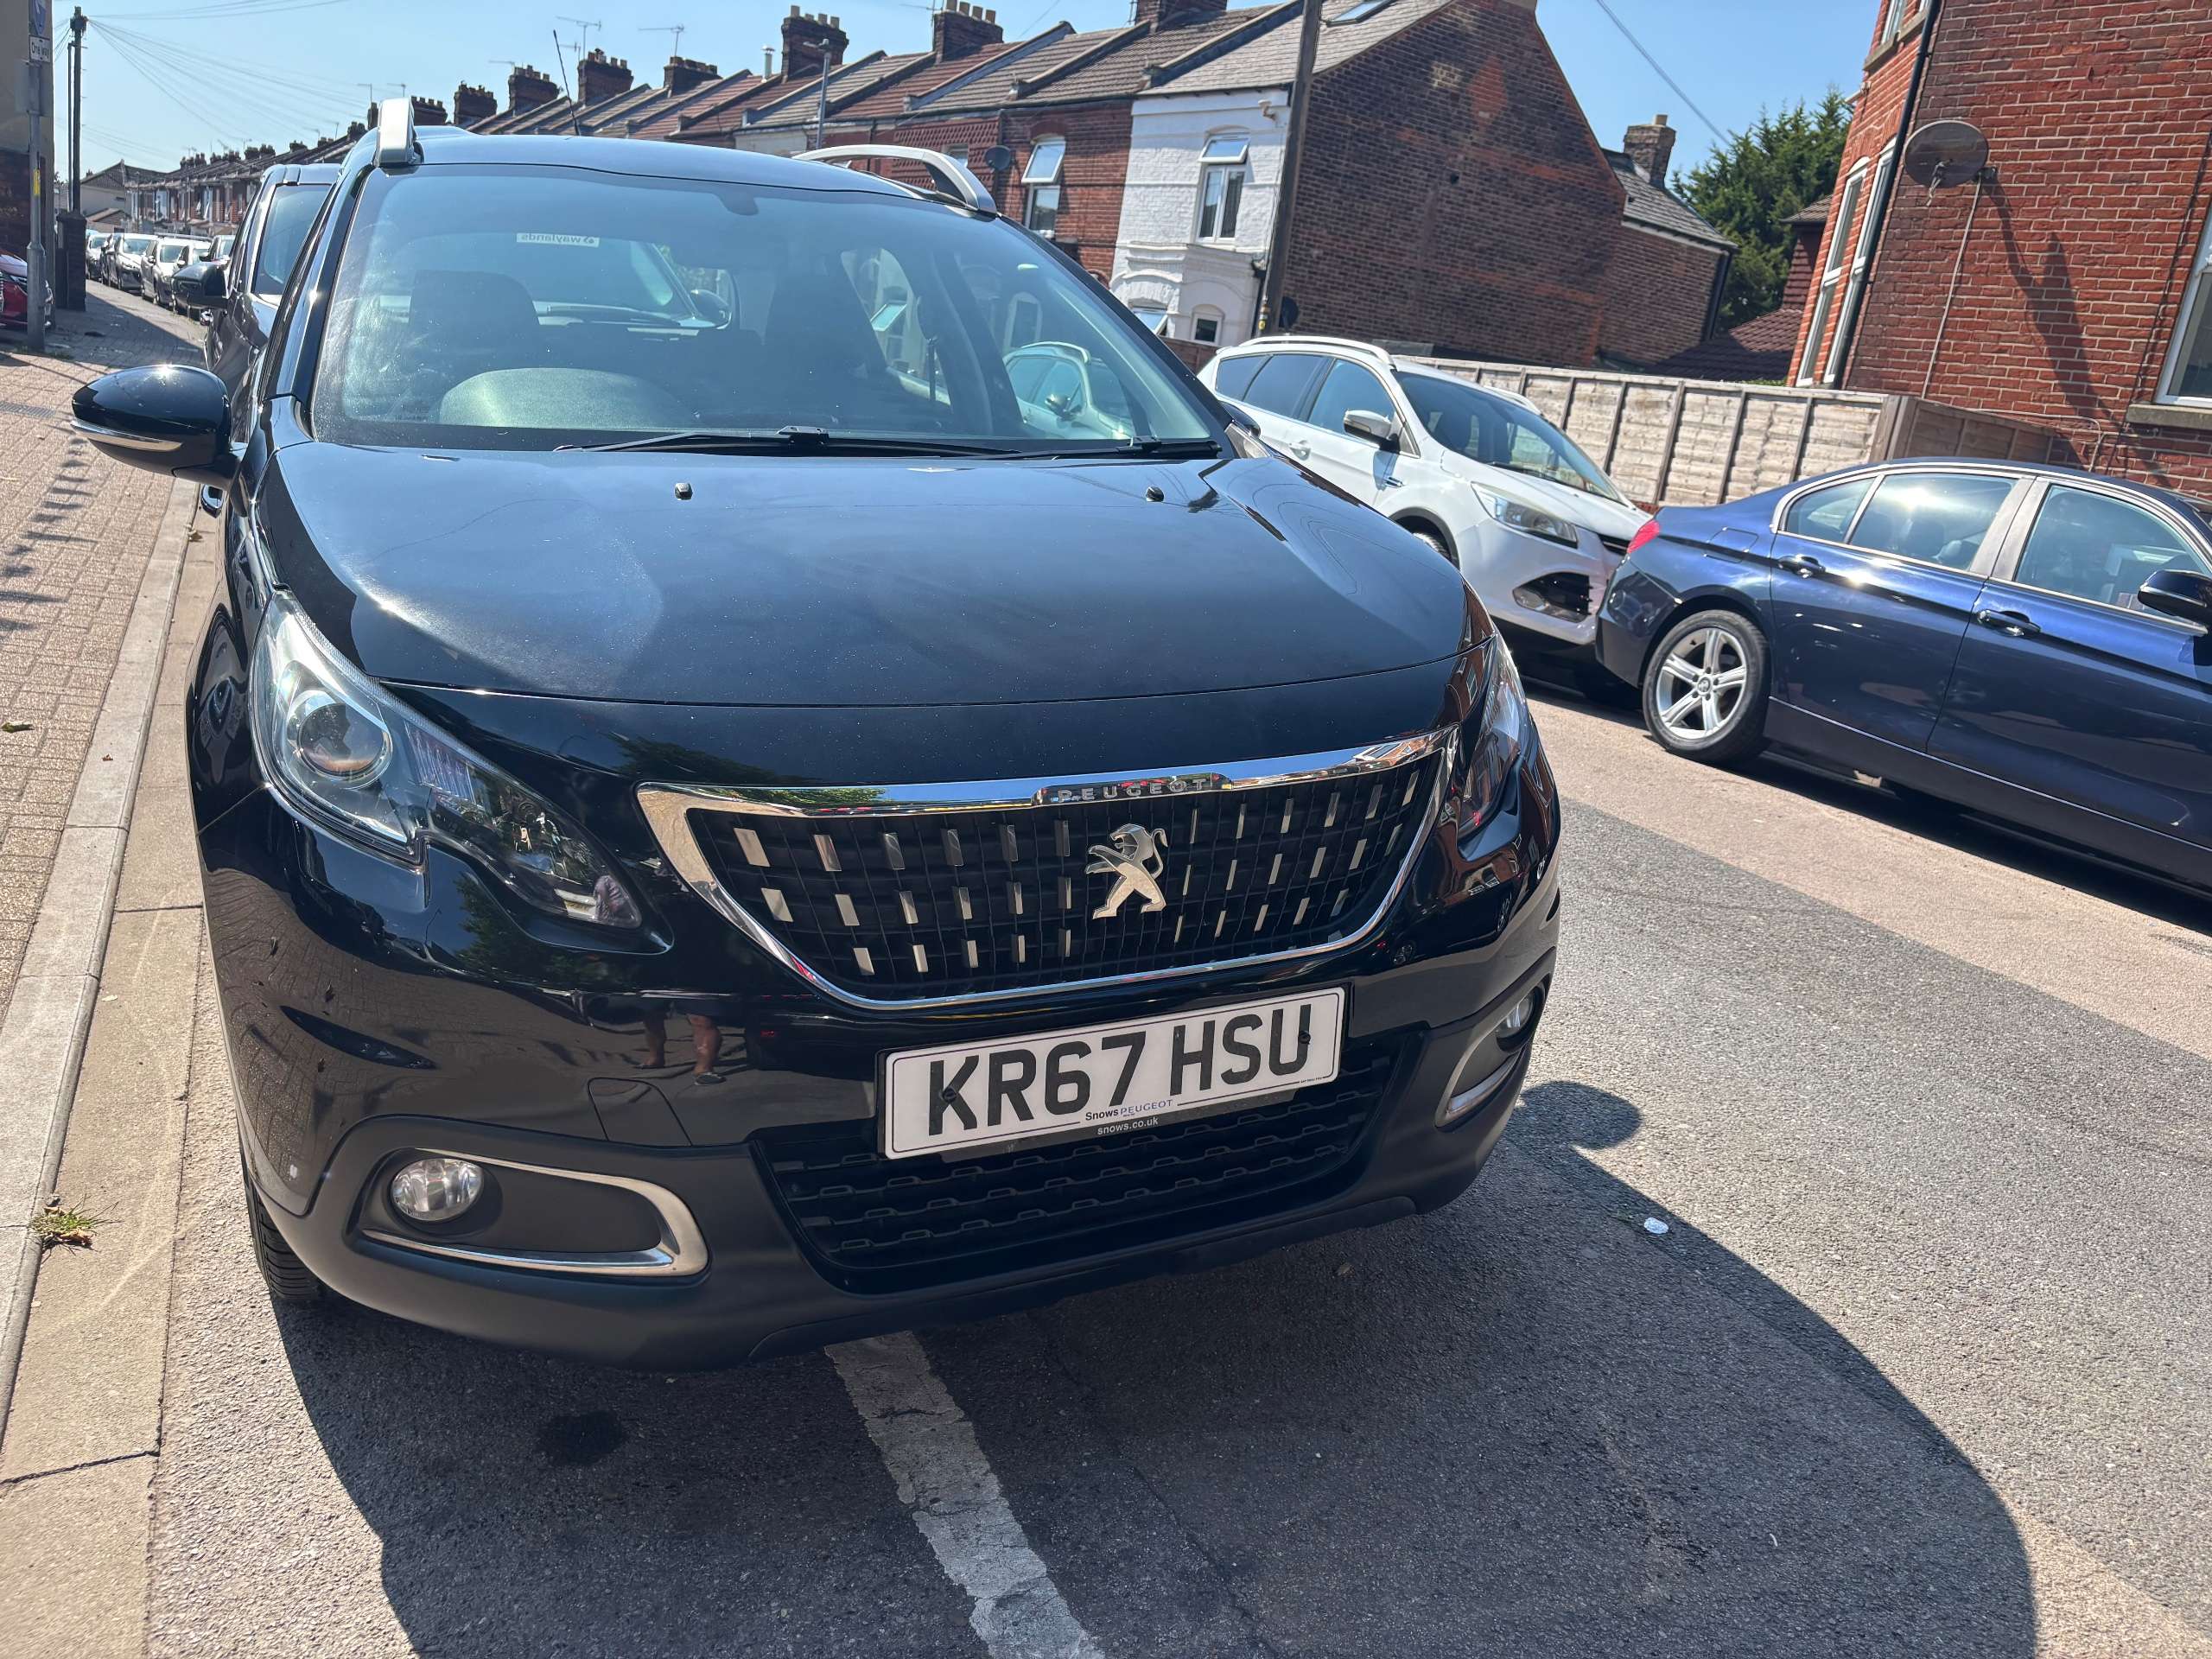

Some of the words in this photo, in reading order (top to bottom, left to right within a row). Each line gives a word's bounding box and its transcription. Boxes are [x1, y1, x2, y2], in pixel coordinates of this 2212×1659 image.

[1057, 778, 1208, 803] PEUGEOT
[928, 1031, 1147, 1136] KR67
[1169, 1003, 1313, 1096] HSU
[1085, 1108, 1119, 1122] Snows
[1120, 1099, 1173, 1116] PEUGEOT
[1097, 1116, 1159, 1135] snows.co.uk
